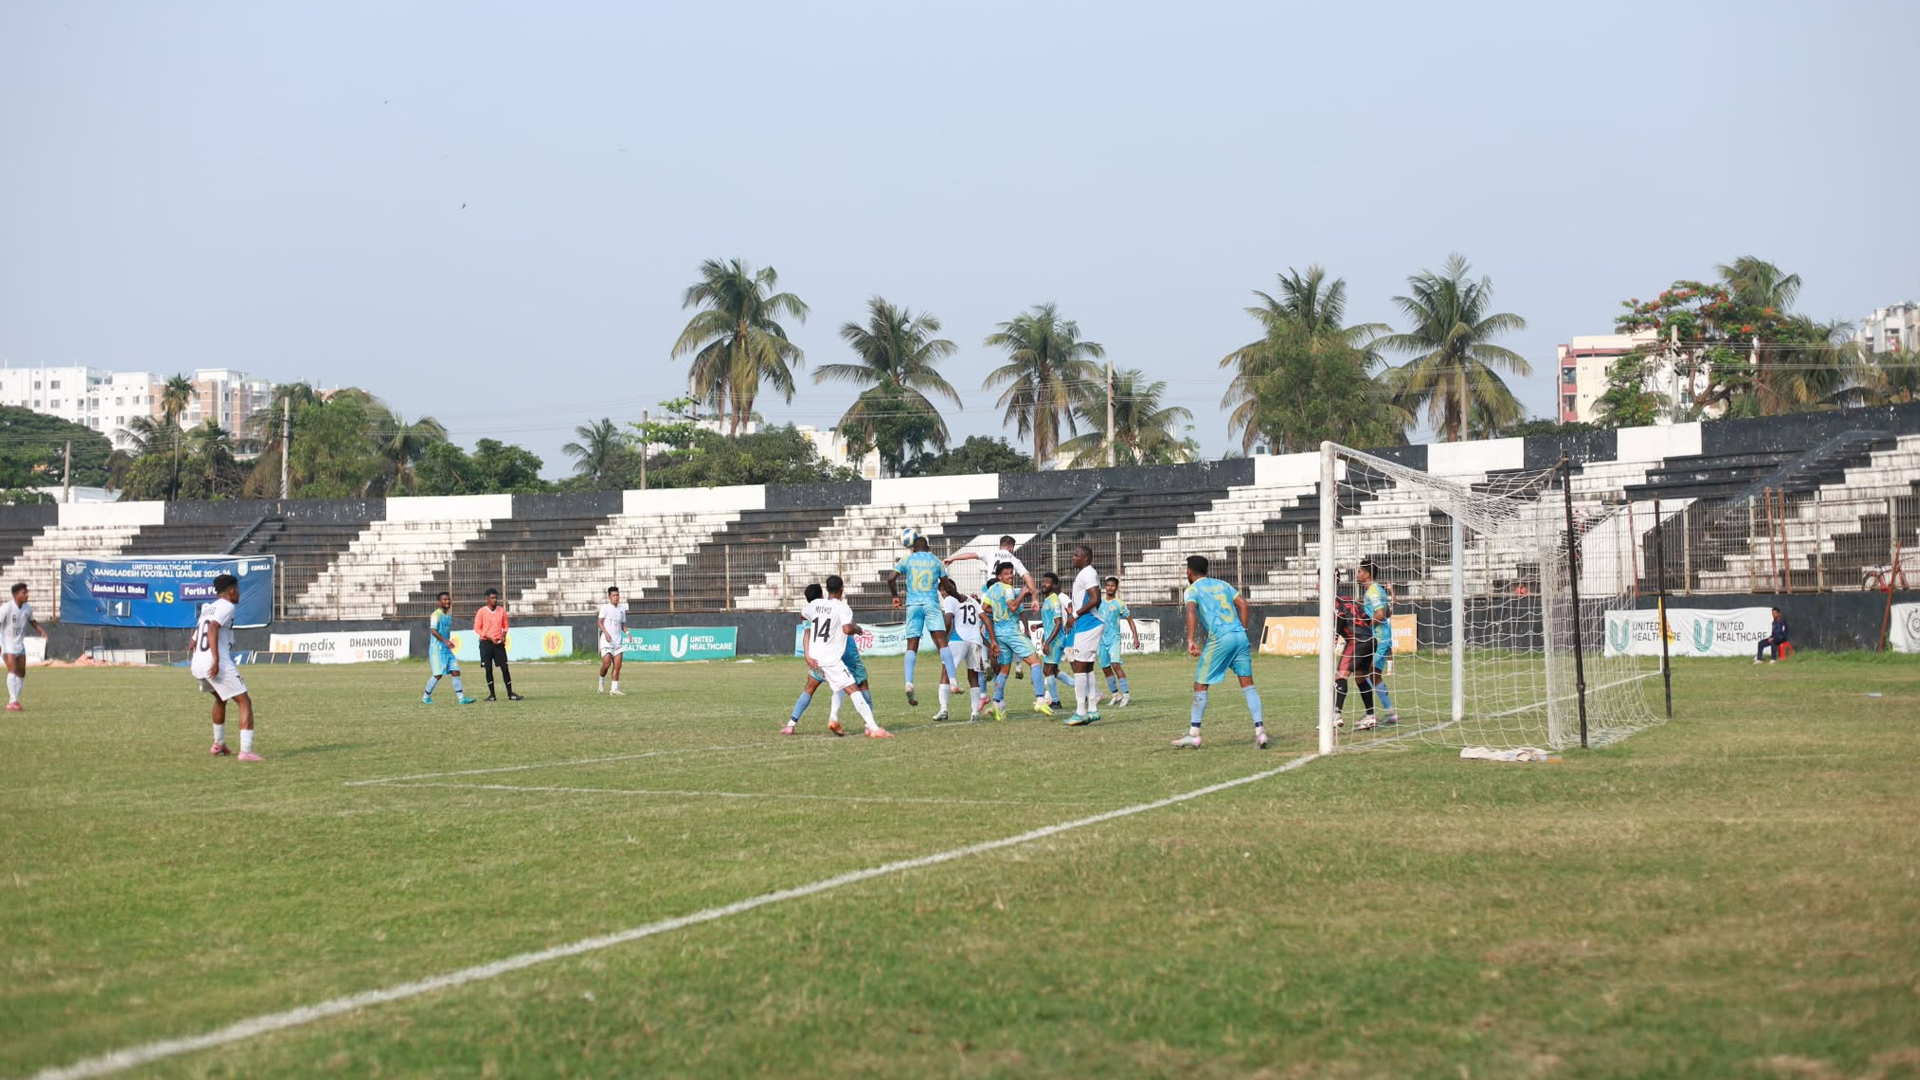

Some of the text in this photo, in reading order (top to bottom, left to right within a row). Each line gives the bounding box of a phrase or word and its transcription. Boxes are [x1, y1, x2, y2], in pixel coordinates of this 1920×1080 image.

[94, 568, 139, 577] BANGLADESH
[140, 570, 174, 578] FOOTBALL
[175, 570, 202, 578] LEAGUE
[911, 568, 934, 592] 10
[127, 585, 146, 594] Dhaka
[184, 587, 206, 596] Fortis
[154, 591, 174, 604] VS
[115, 601, 123, 616] 1
[1213, 594, 1235, 623] 3
[959, 604, 977, 626] 13
[811, 617, 832, 643] 14
[1632, 621, 1661, 631] UNITED
[1716, 621, 1745, 631] UNITED
[1288, 627, 1315, 637] United
[1716, 632, 1768, 642] HEALTHCARE
[349, 637, 402, 648] DHANMONDI
[690, 635, 714, 643] UNITED
[298, 638, 336, 651] medix
[689, 642, 733, 651] HEALTHCARE
[366, 649, 395, 659] 10688
